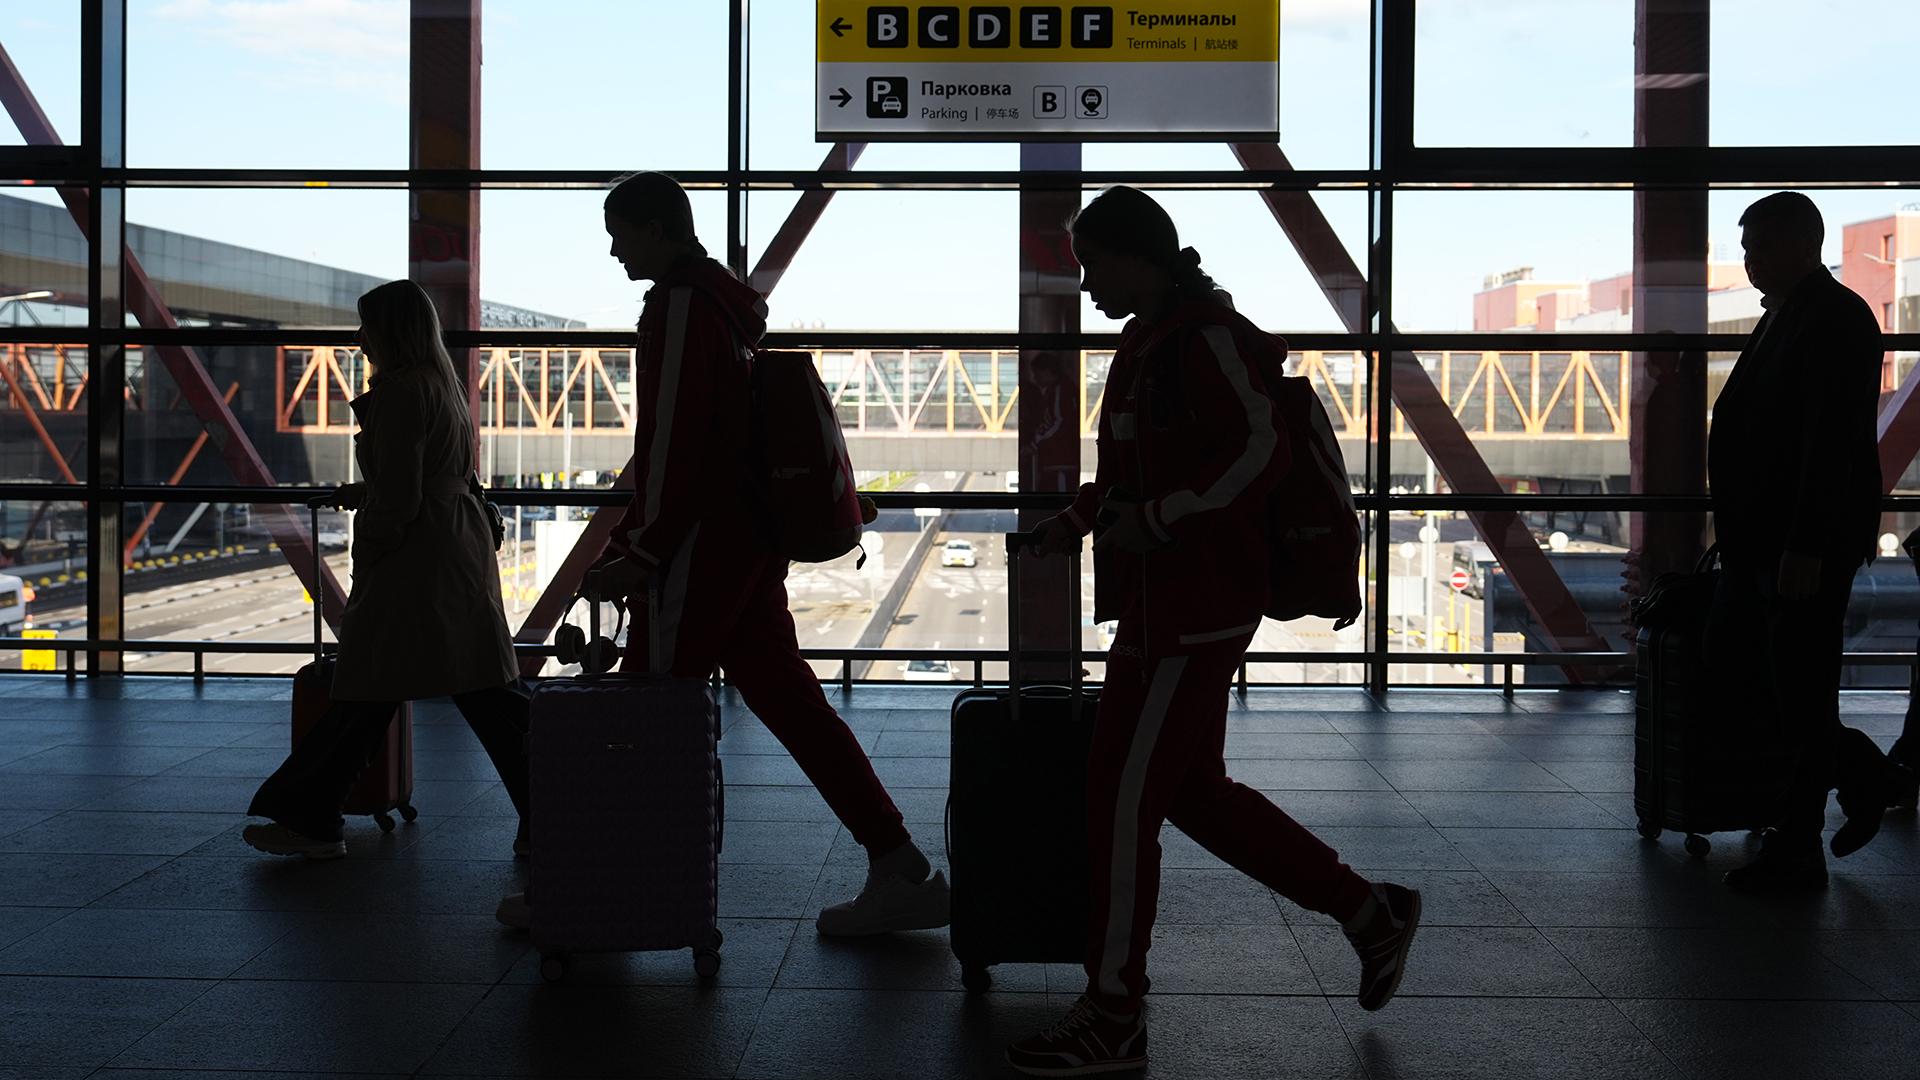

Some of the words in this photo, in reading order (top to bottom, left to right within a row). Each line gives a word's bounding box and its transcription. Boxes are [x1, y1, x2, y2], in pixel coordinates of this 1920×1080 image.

[877, 13, 898, 41] B
[927, 14, 949, 42] C
[977, 13, 1001, 41] D
[1031, 14, 1049, 41] E
[1083, 14, 1101, 41] F
[1127, 11, 1236, 30] Терминалы
[1127, 37, 1187, 50] Terminals
[872, 80, 892, 102] P
[921, 81, 1012, 99] Парковка
[1041, 91, 1058, 113] B
[921, 107, 968, 122] Parking
[986, 107, 1020, 119] 停车场
